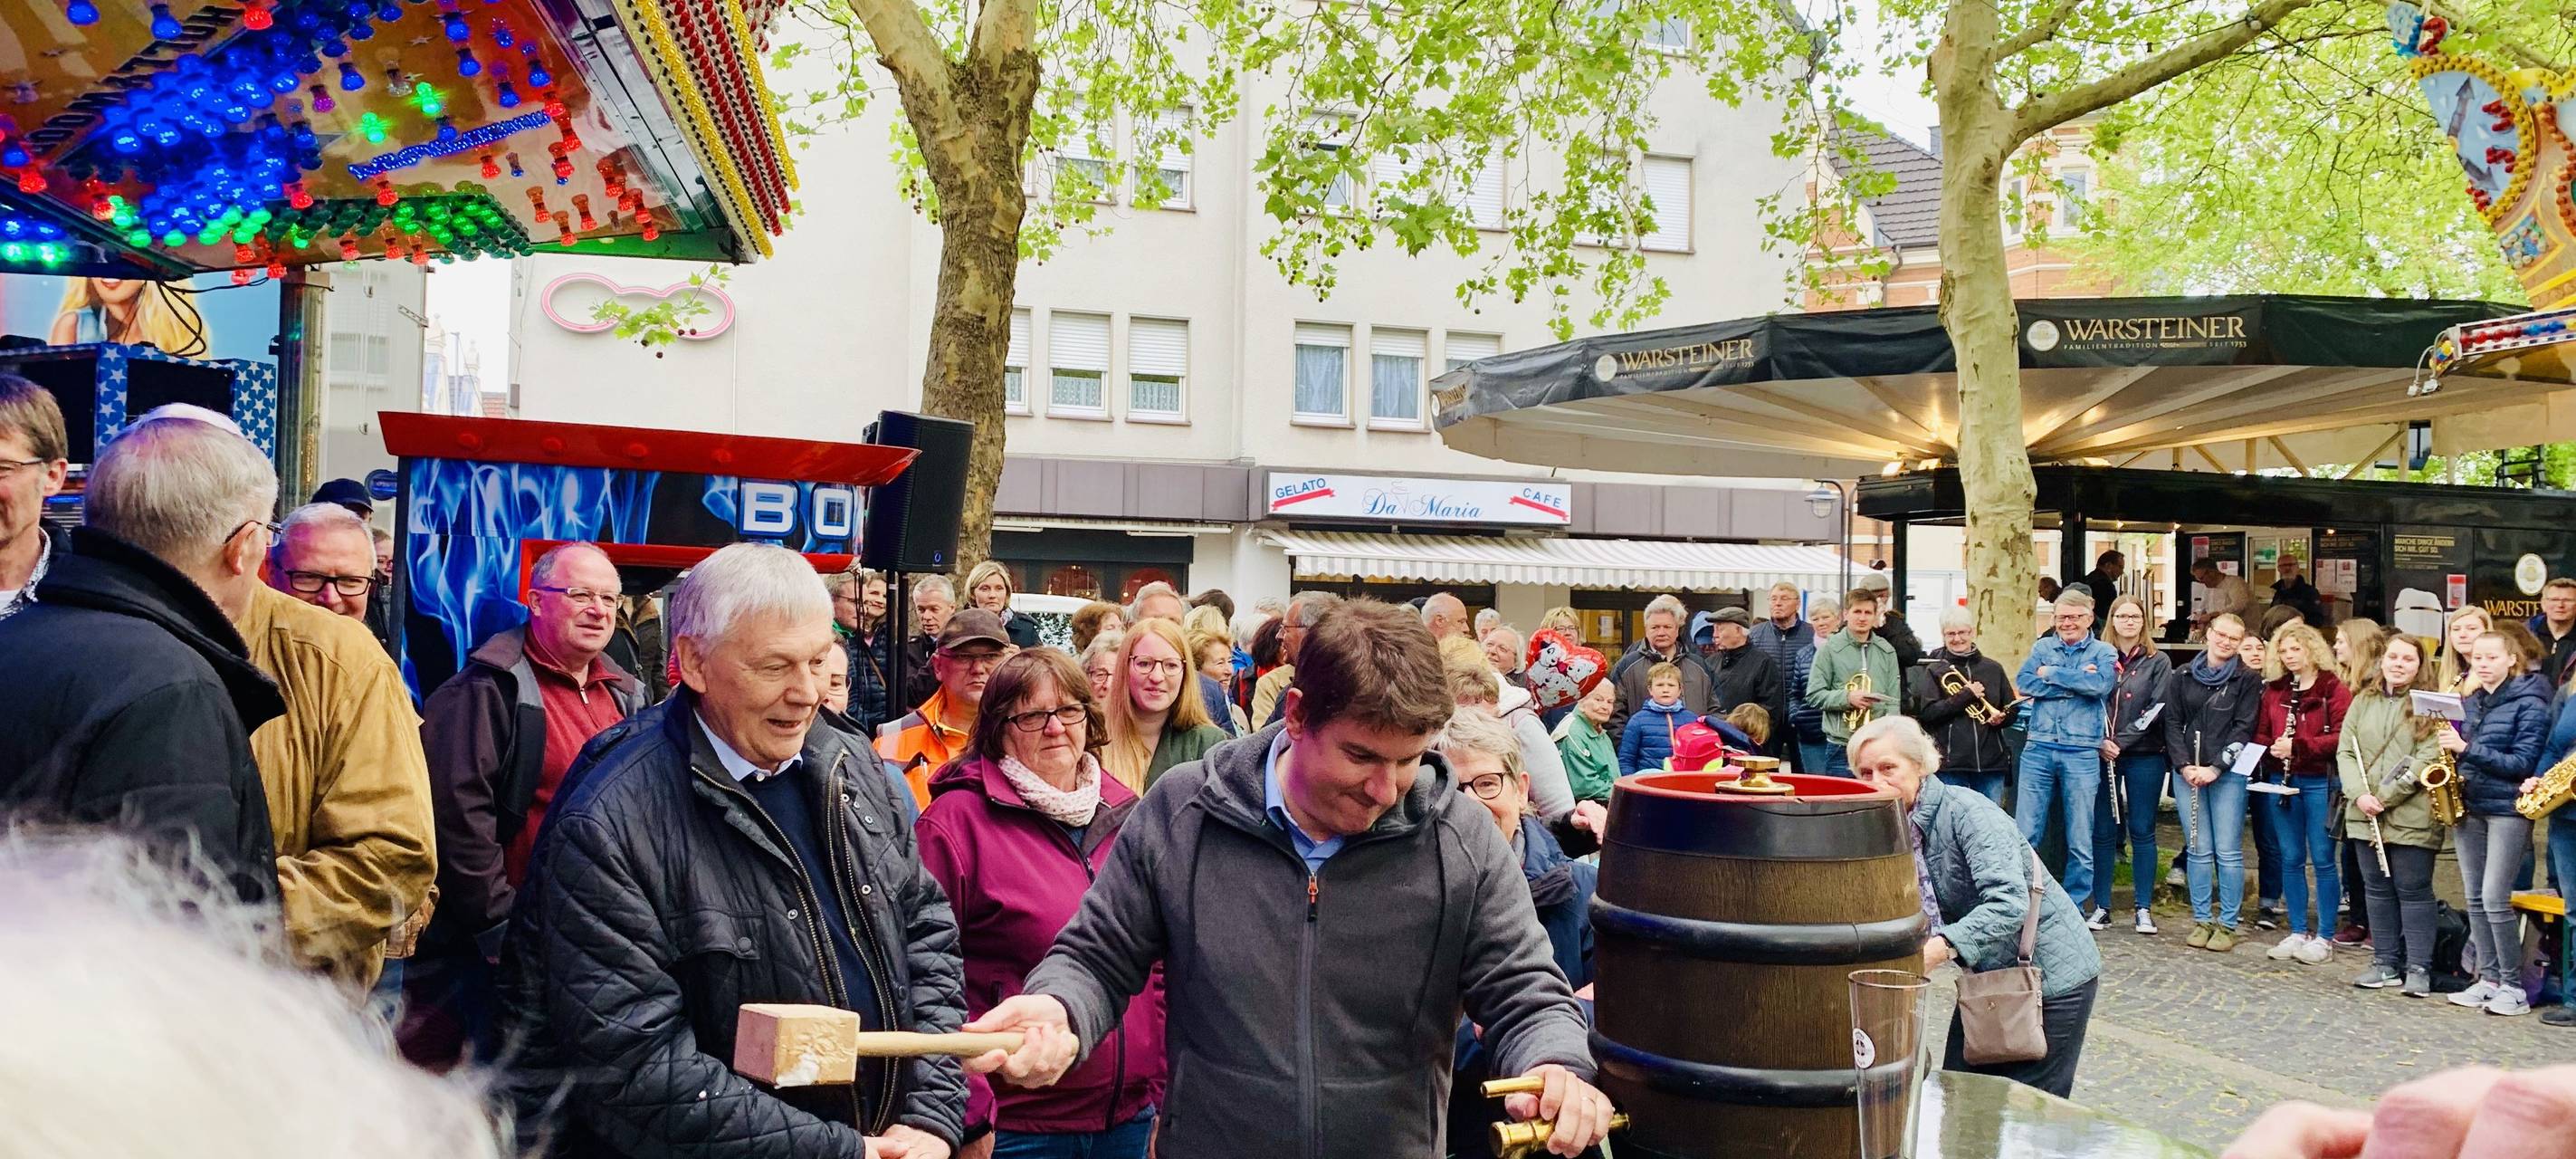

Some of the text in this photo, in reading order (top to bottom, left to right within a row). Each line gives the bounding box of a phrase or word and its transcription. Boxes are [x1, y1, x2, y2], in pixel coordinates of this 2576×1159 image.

[2064, 316, 2247, 340] WARSTEINER
[1620, 339, 1754, 371] WARSTEINER
[2064, 341, 2161, 350] FAMILIENTRADITION
[2230, 340, 2247, 349] 1753
[1274, 477, 1327, 499] GELATO
[1522, 486, 1562, 508] CAFE
[1365, 490, 1483, 518] Da Maria
